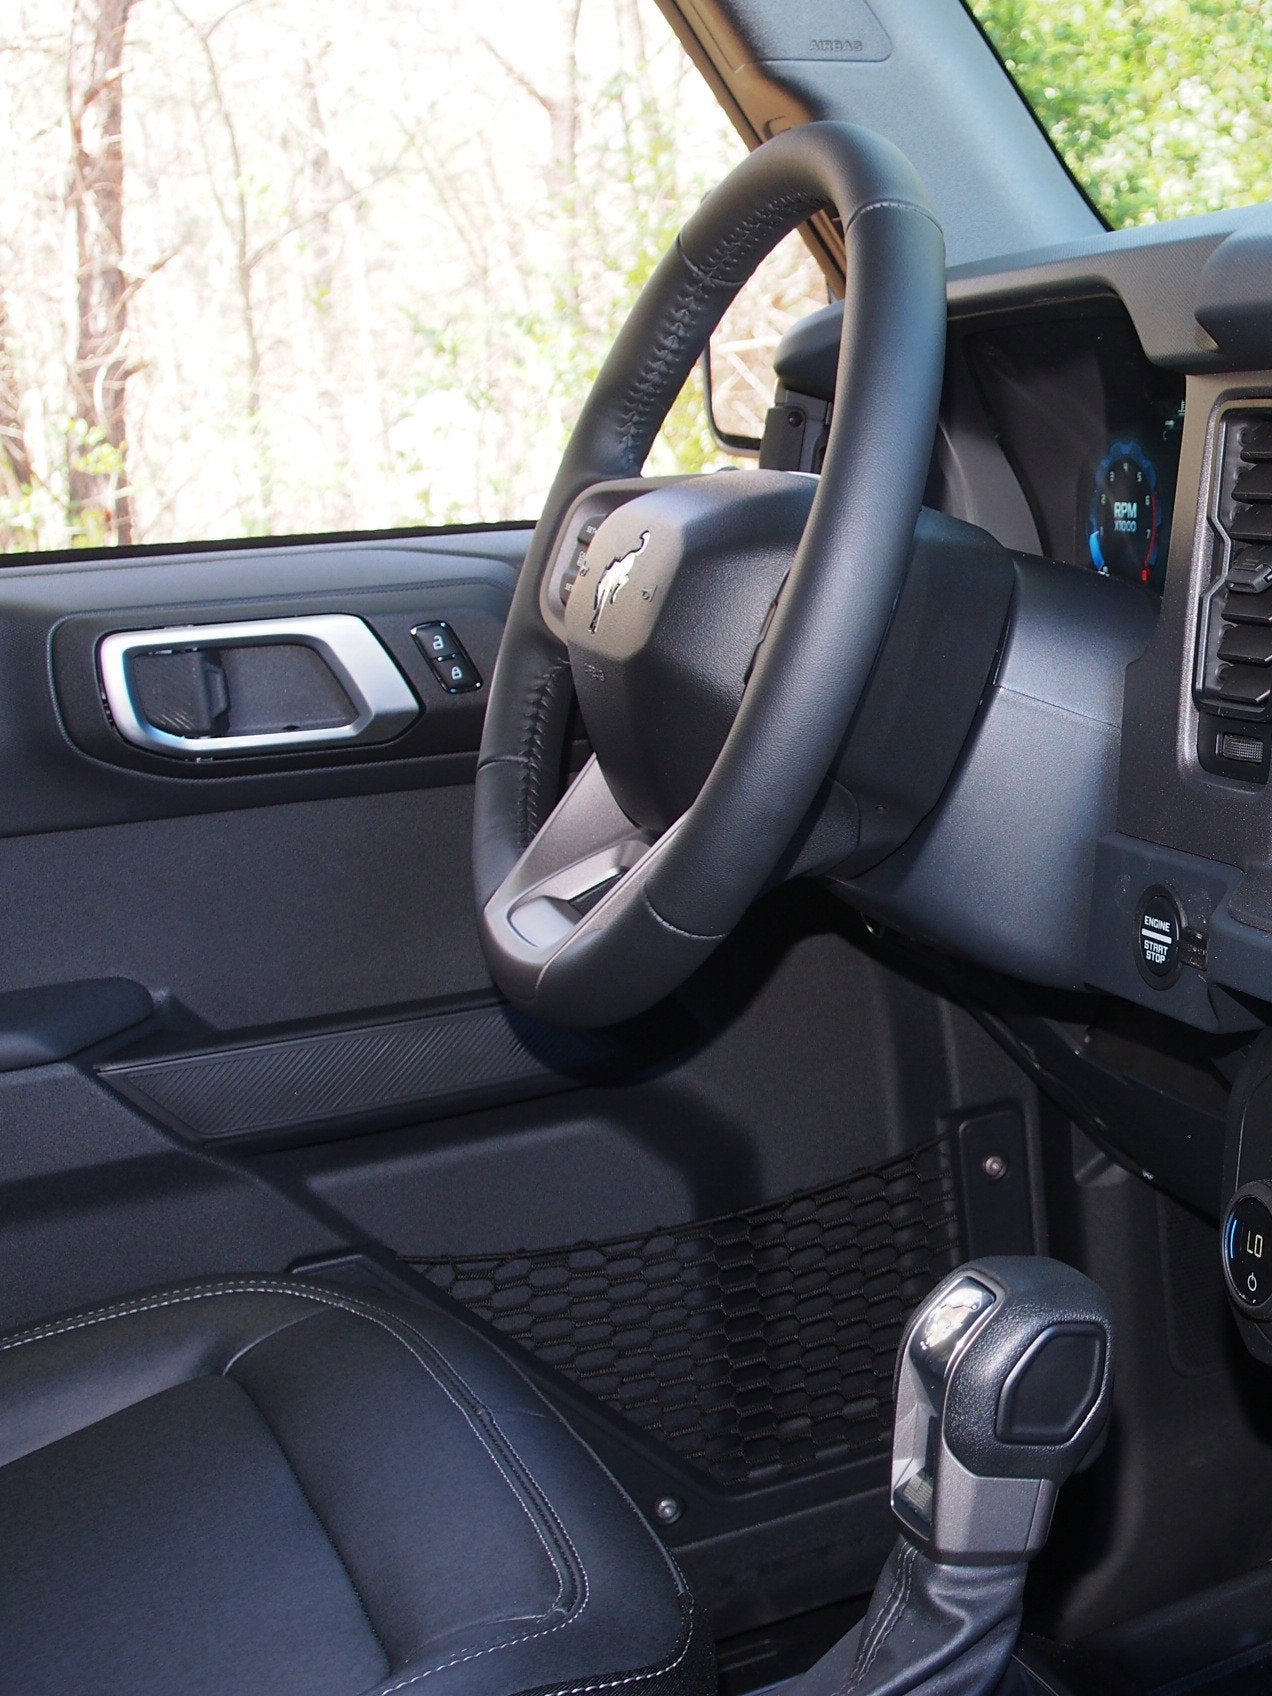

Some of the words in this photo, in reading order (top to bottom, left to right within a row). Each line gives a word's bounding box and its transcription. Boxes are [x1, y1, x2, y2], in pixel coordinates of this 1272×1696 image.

[808, 39, 863, 51] AIRBAG
[1113, 502, 1138, 518] RPM
[1144, 915, 1171, 933] ENGINE
[1144, 939, 1168, 956] START
[1146, 950, 1166, 964] STOP
[1246, 1230, 1263, 1258] LO
